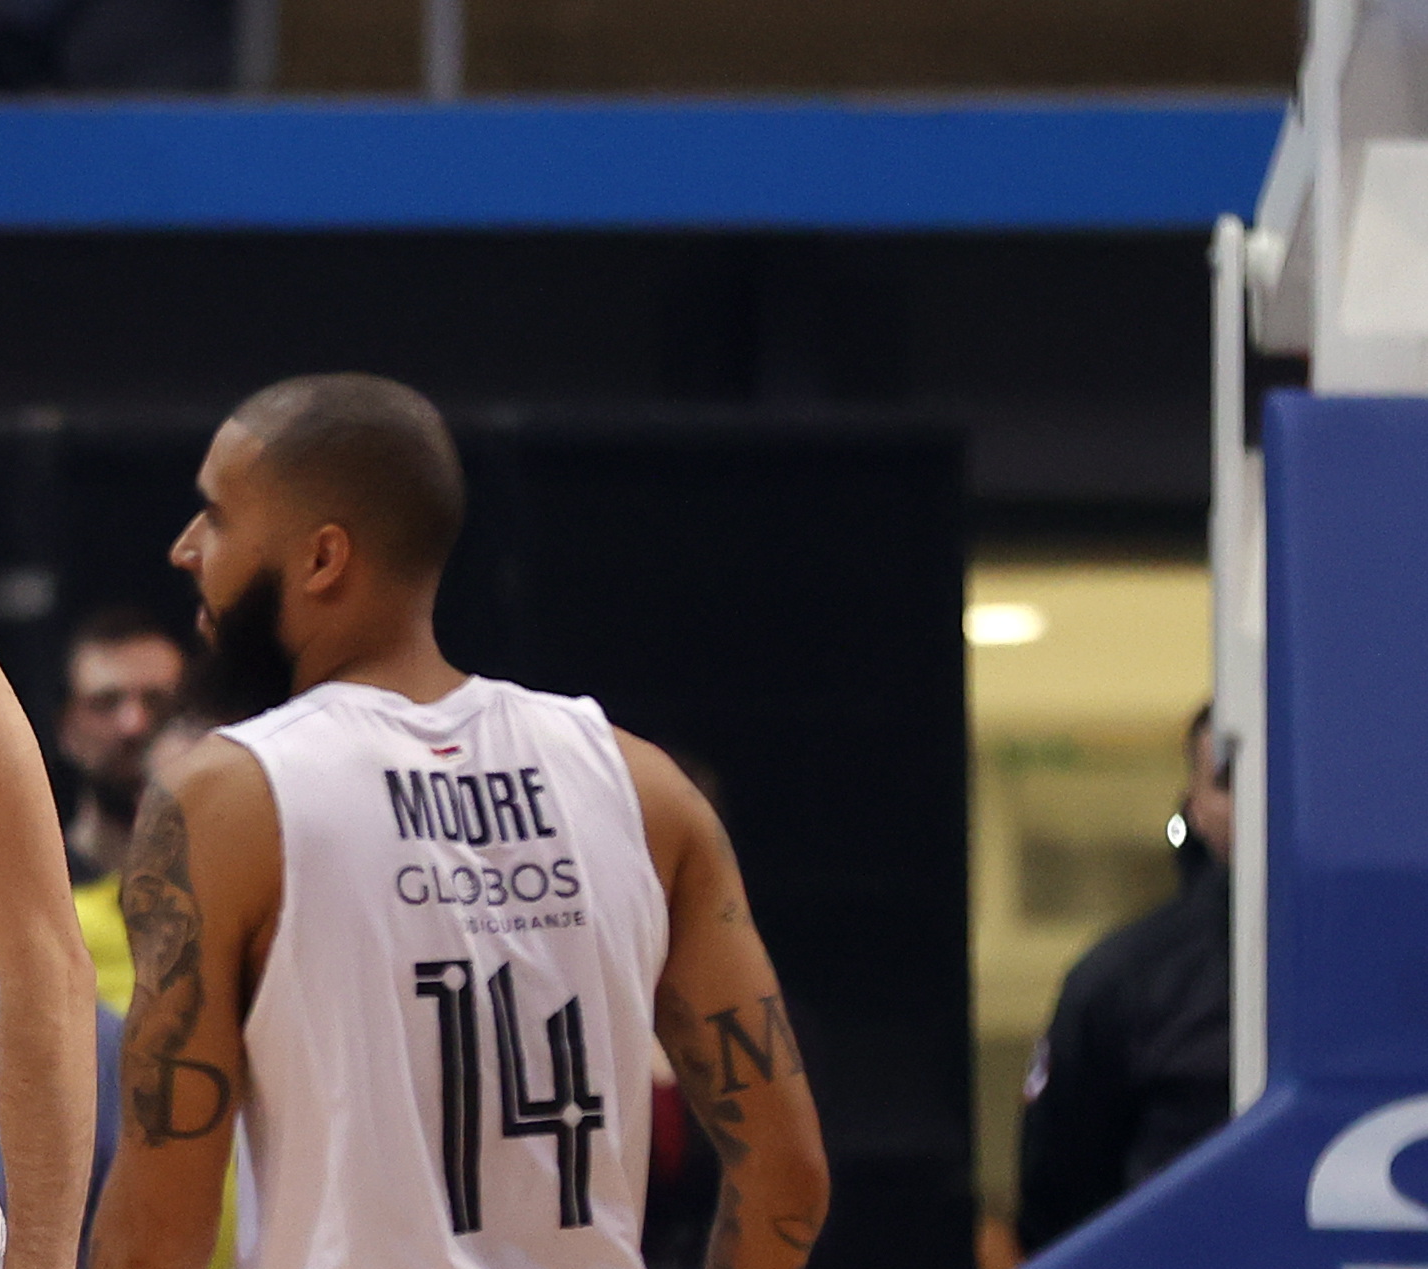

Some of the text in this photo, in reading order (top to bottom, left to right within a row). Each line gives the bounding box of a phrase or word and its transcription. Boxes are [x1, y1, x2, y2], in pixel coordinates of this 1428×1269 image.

[385, 768, 557, 847] MOORE
[397, 858, 581, 906] GLOBOS
[466, 910, 586, 934] SIGURANJE
[415, 960, 605, 1235] 14
